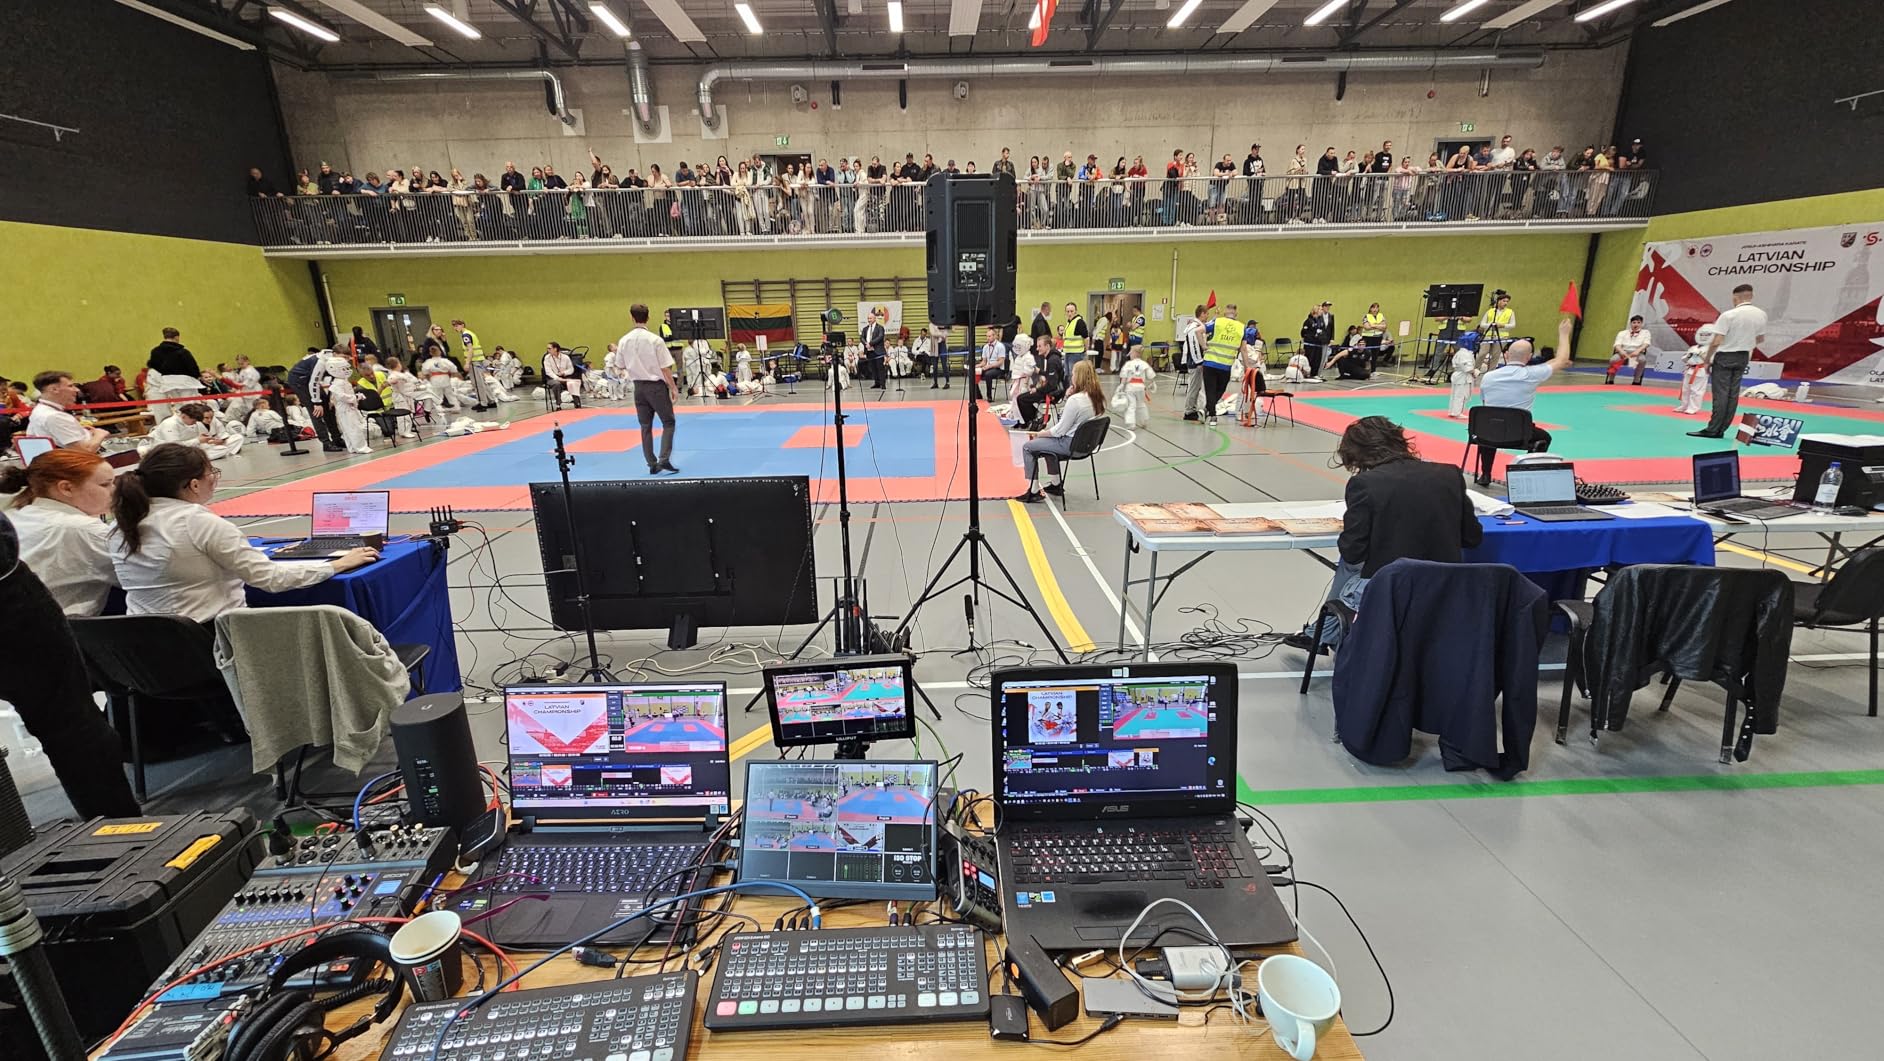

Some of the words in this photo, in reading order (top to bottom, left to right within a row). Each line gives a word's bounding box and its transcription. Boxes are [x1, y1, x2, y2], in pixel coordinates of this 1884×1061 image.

[1737, 250, 1805, 262] LATVIAN
[1708, 261, 1836, 276] CHAMPIONSHIP
[1667, 361, 1674, 370] 2
[905, 854, 922, 862] STOP
